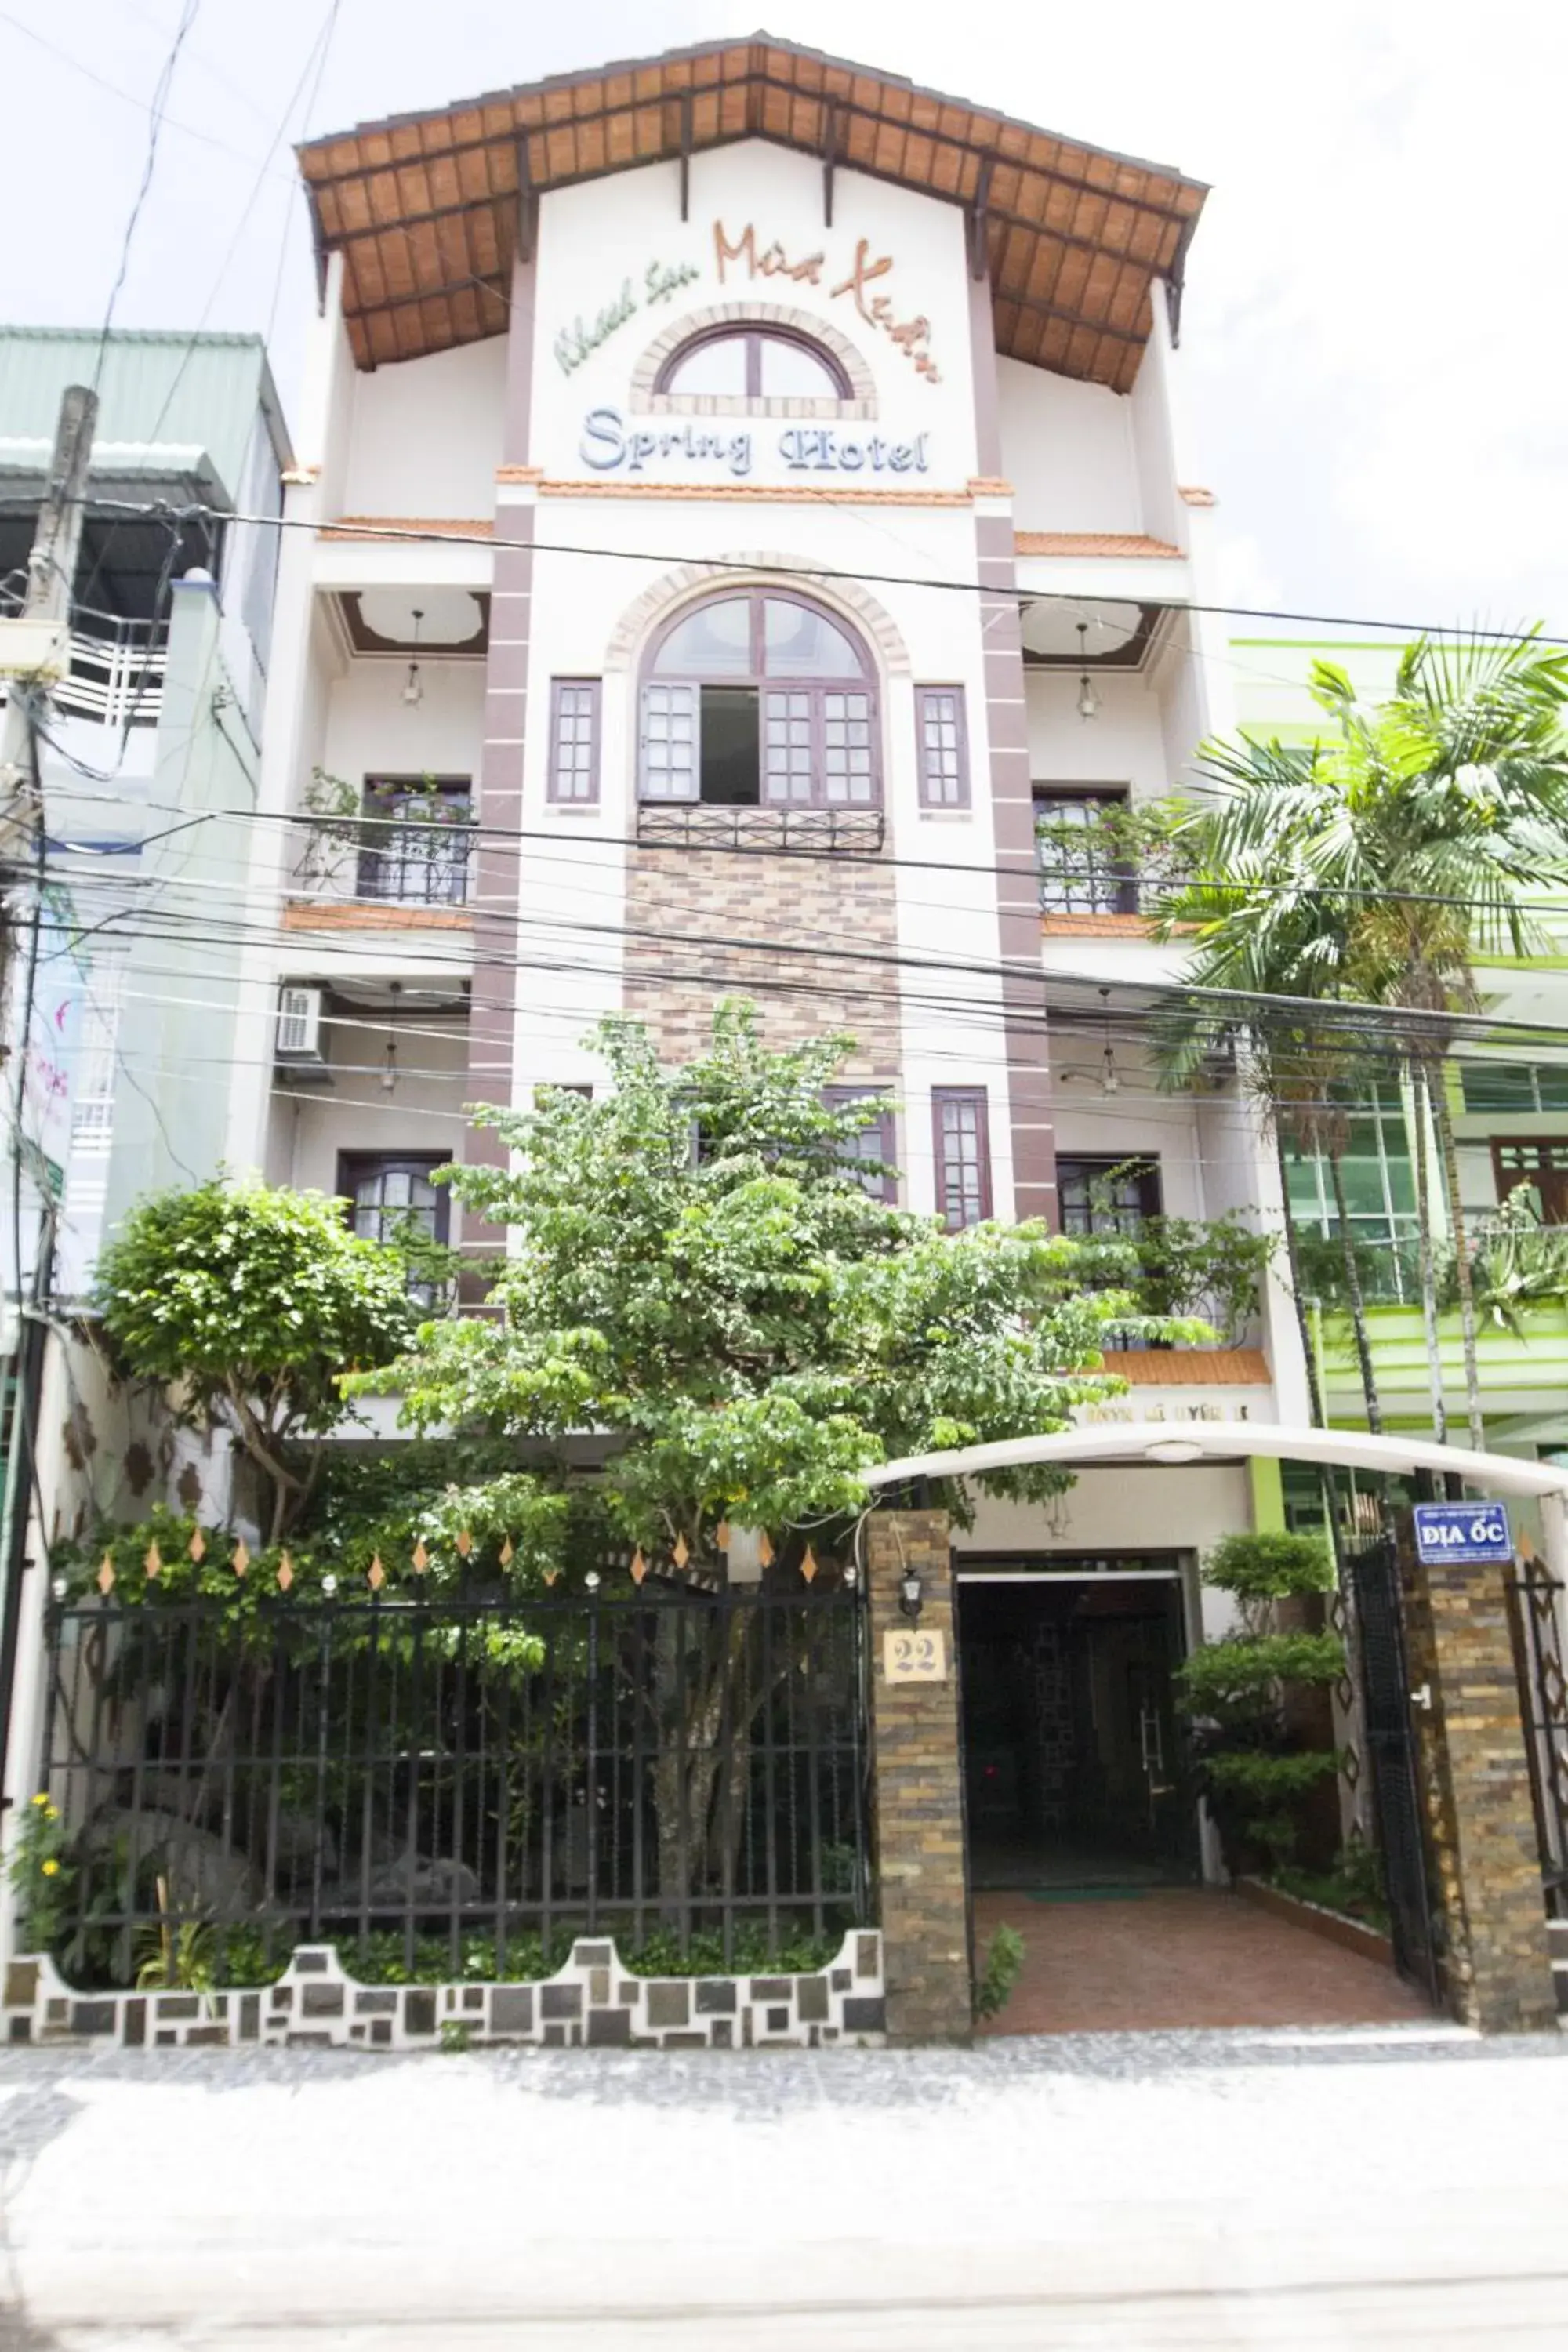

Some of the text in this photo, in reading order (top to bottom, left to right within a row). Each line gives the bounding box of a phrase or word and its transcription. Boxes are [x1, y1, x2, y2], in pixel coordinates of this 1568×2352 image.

[580, 408, 931, 476] Spring Hotel
[894, 1637, 936, 1671] 22
